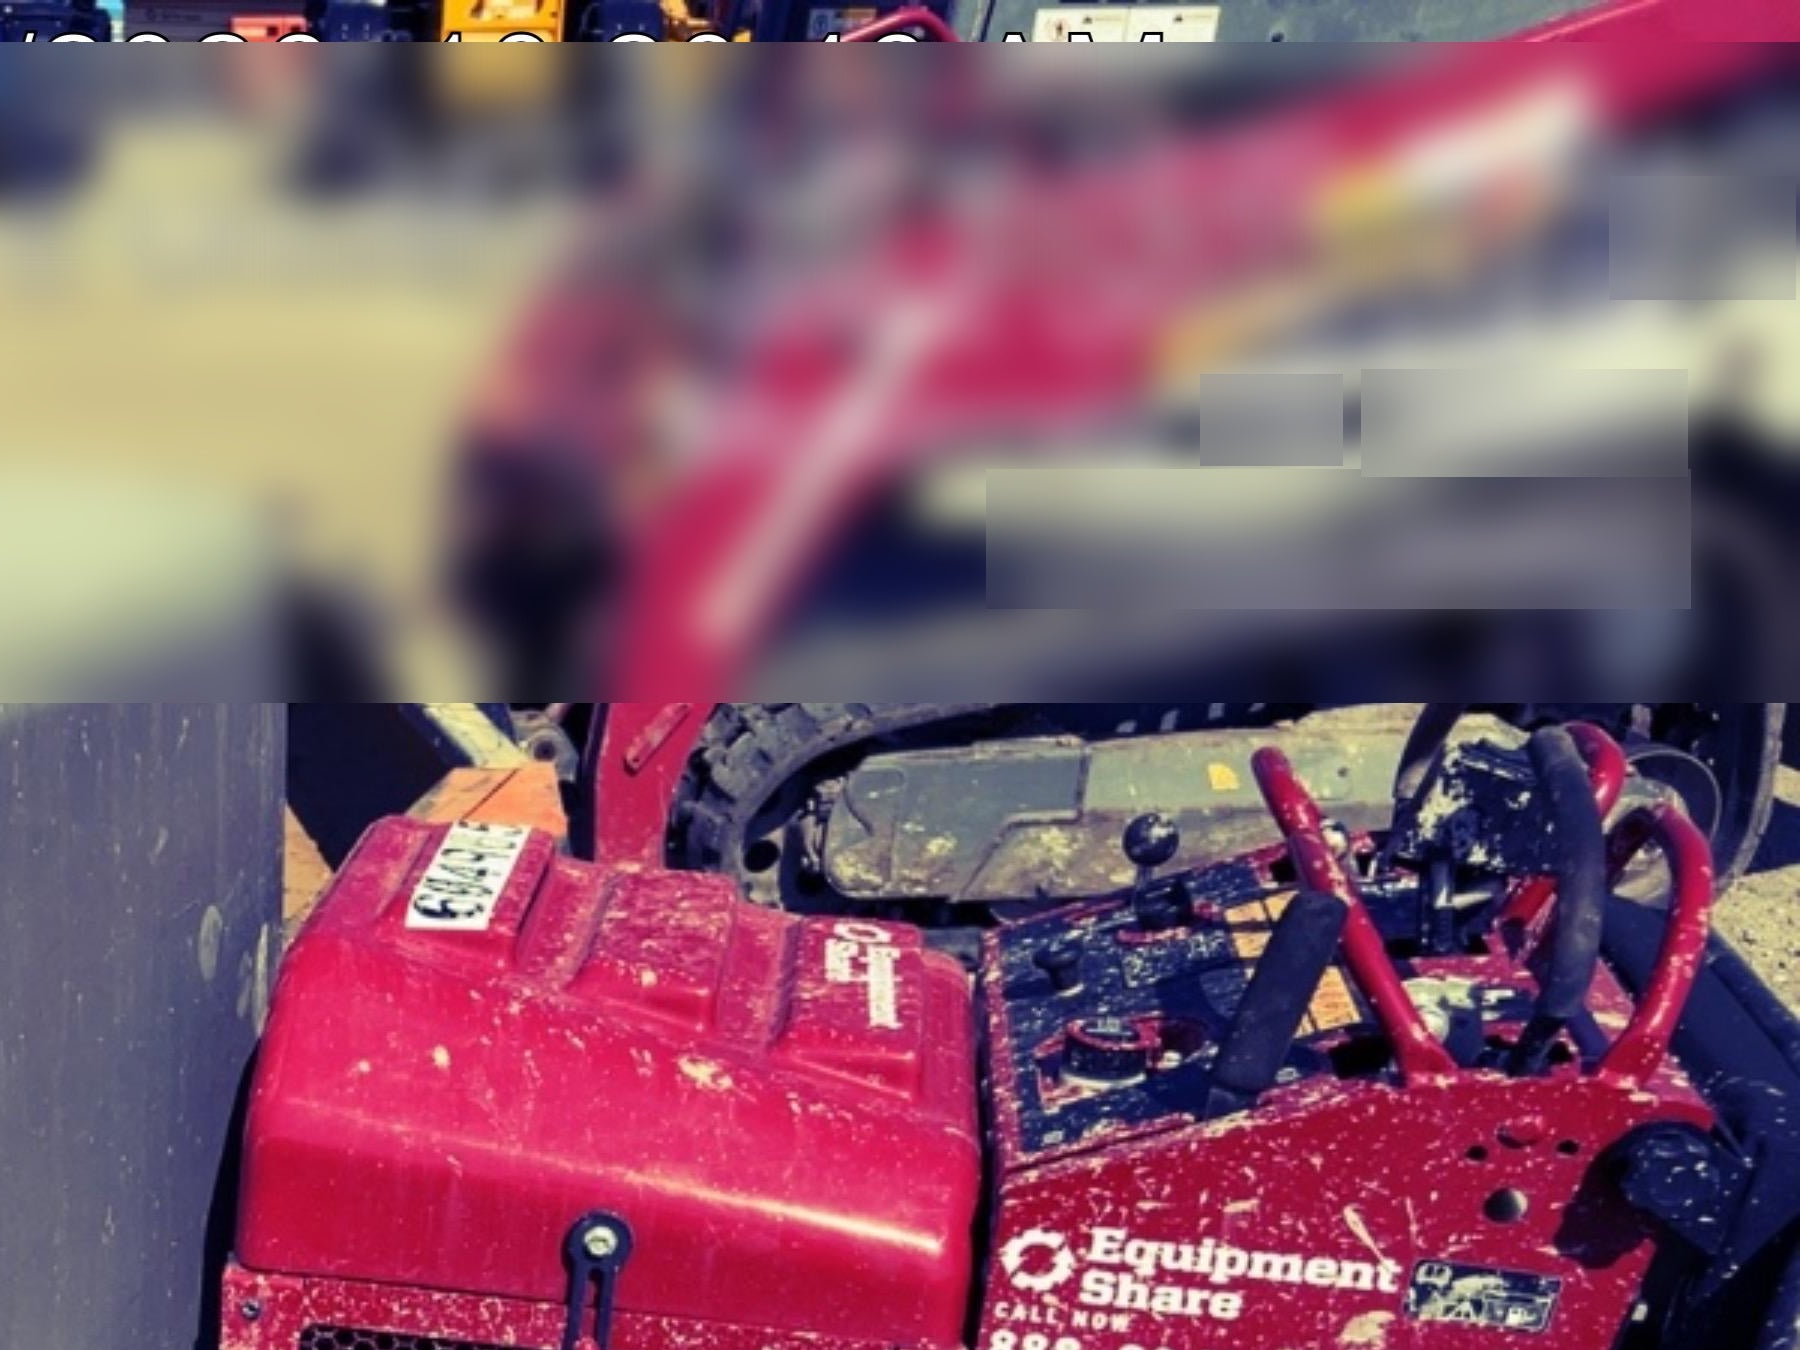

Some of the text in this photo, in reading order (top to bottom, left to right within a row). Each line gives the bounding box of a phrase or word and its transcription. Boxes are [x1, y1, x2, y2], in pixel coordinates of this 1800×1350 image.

[1086, 1226, 1402, 1294] Equipment
[994, 1302, 1131, 1333] CALL NOW
[1080, 1270, 1243, 1320] Share
